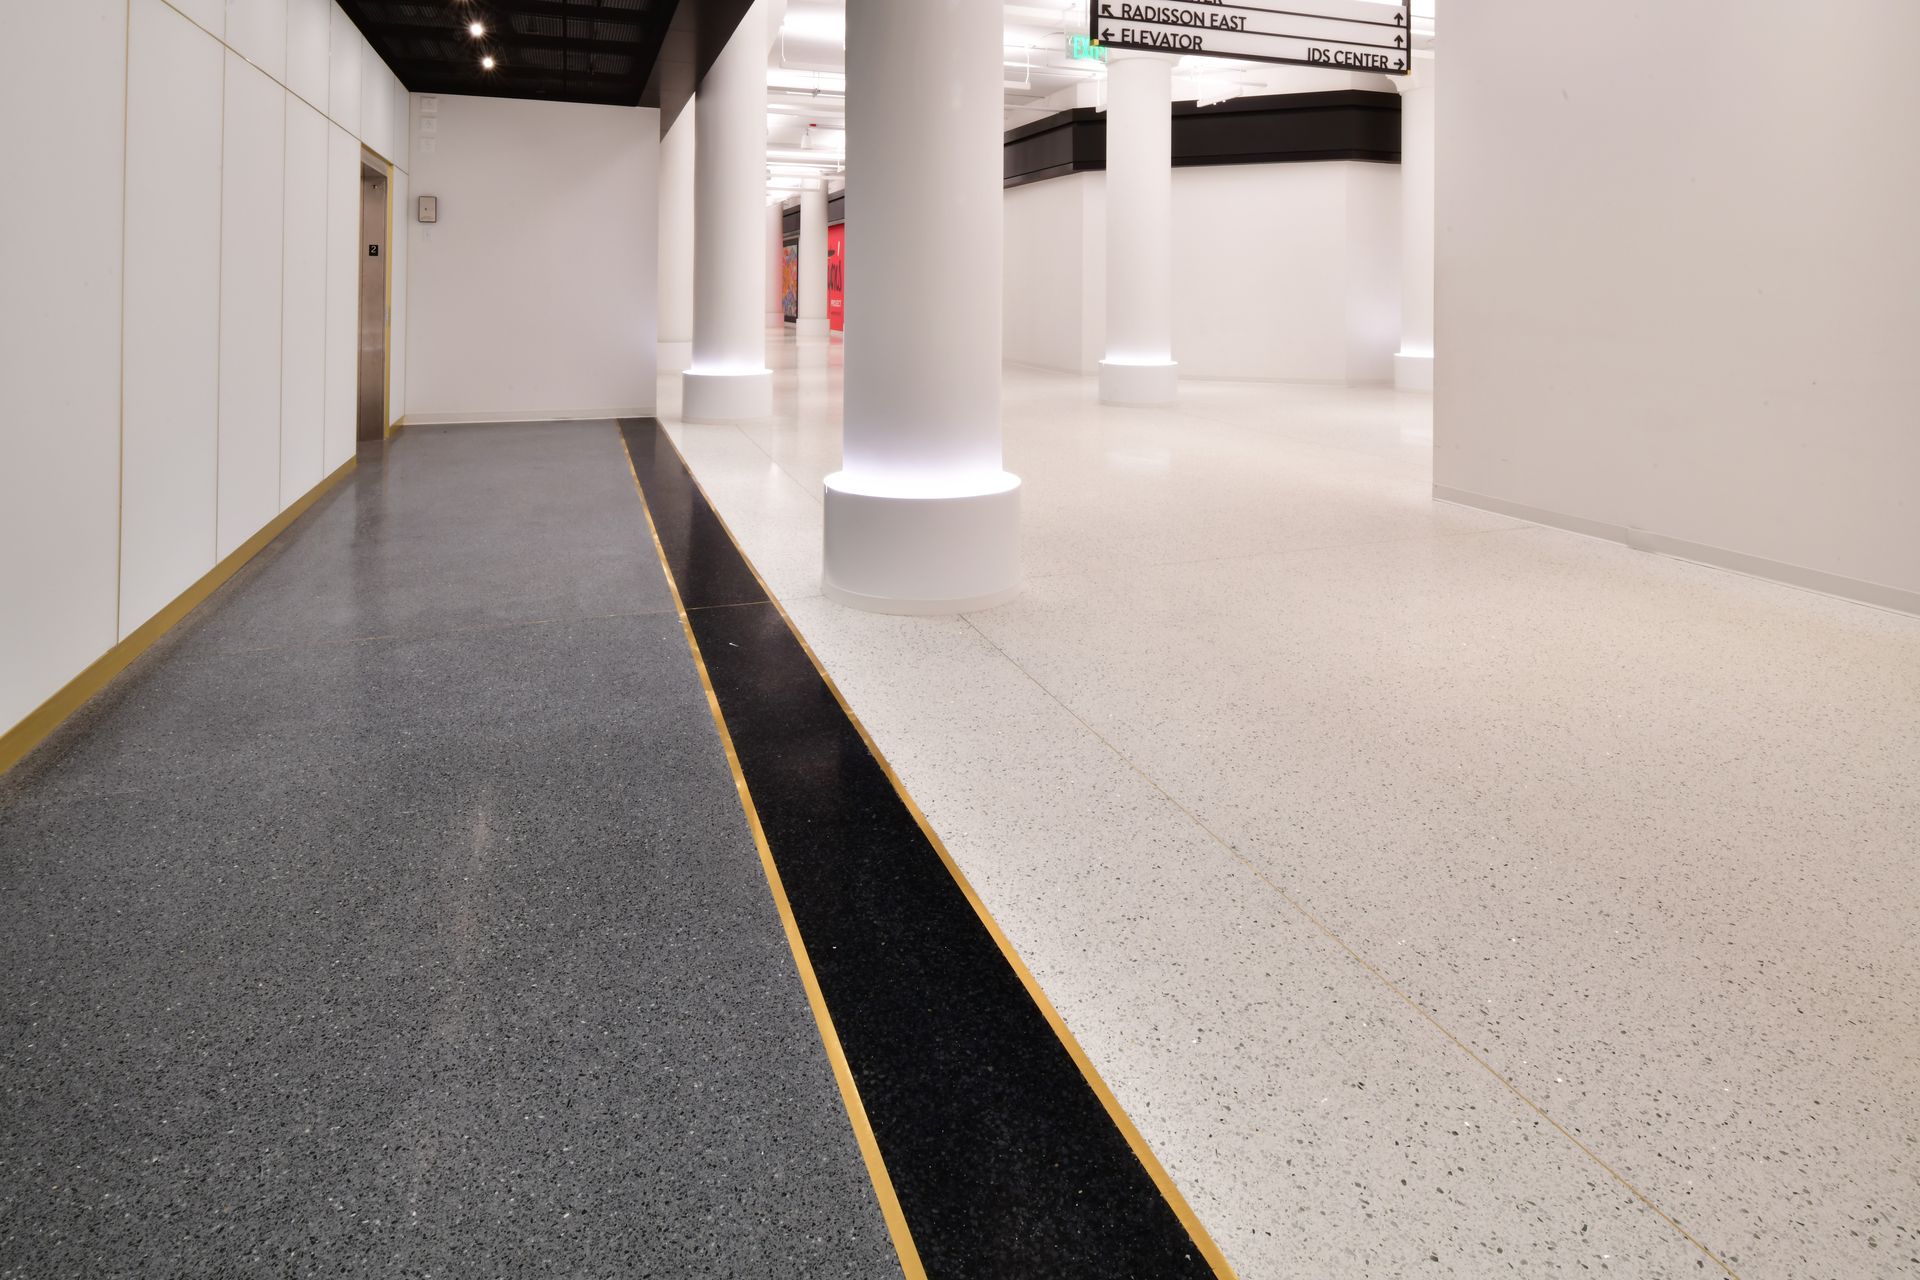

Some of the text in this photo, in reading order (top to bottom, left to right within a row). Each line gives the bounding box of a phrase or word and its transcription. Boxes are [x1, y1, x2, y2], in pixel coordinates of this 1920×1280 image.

[1121, 3, 1247, 32] RADISSON EAST
[1121, 28, 1203, 51] ELEVATOR
[1307, 47, 1389, 70] IDS CENTER
